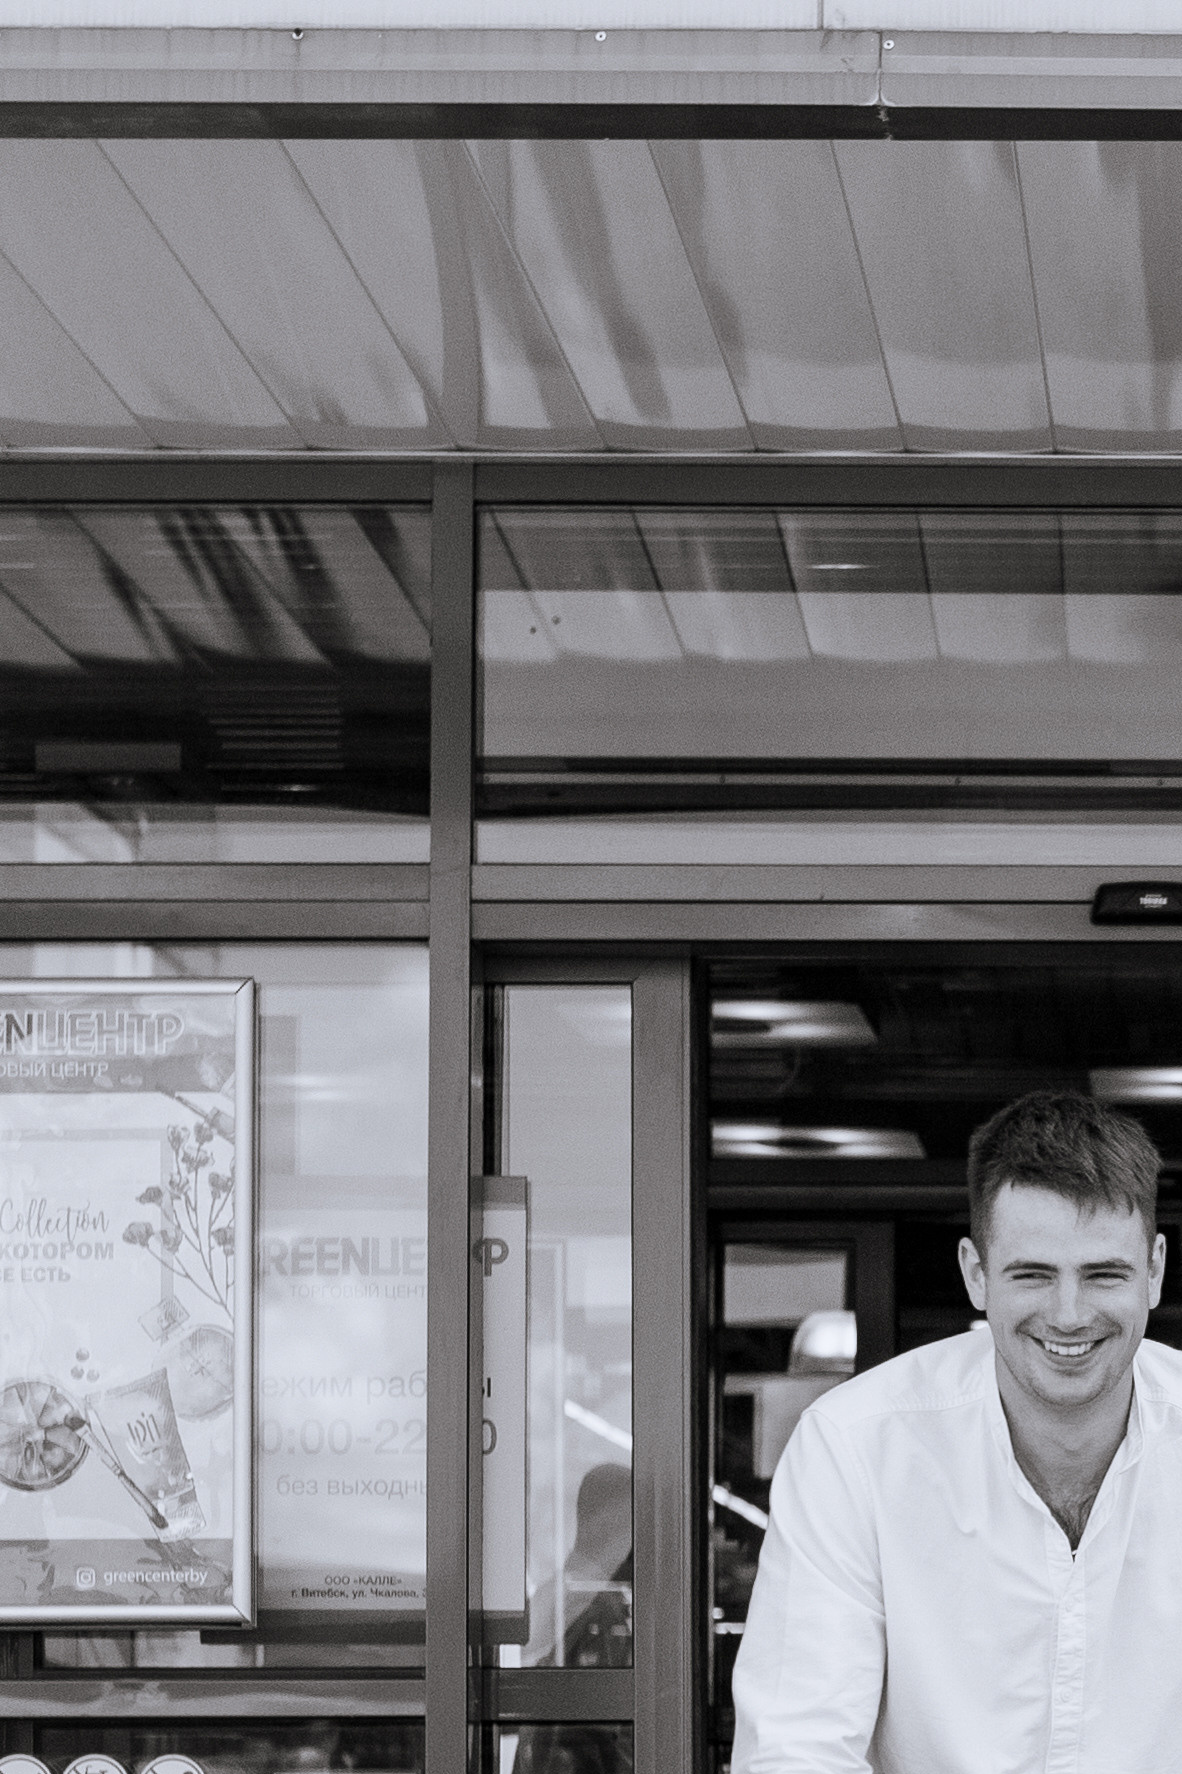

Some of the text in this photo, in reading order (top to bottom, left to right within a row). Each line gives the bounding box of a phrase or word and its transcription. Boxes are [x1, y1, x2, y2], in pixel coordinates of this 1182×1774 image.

[0, 1009, 185, 1056] NЦЕНТР
[51, 1061, 109, 1080] ЦЕНТР
[0, 1198, 110, 1243] Collection
[22, 1267, 71, 1282] ЕСТЬ
[262, 1376, 353, 1398] ежим
[278, 1474, 318, 1497] без
[104, 1568, 208, 1587] greencenterby
